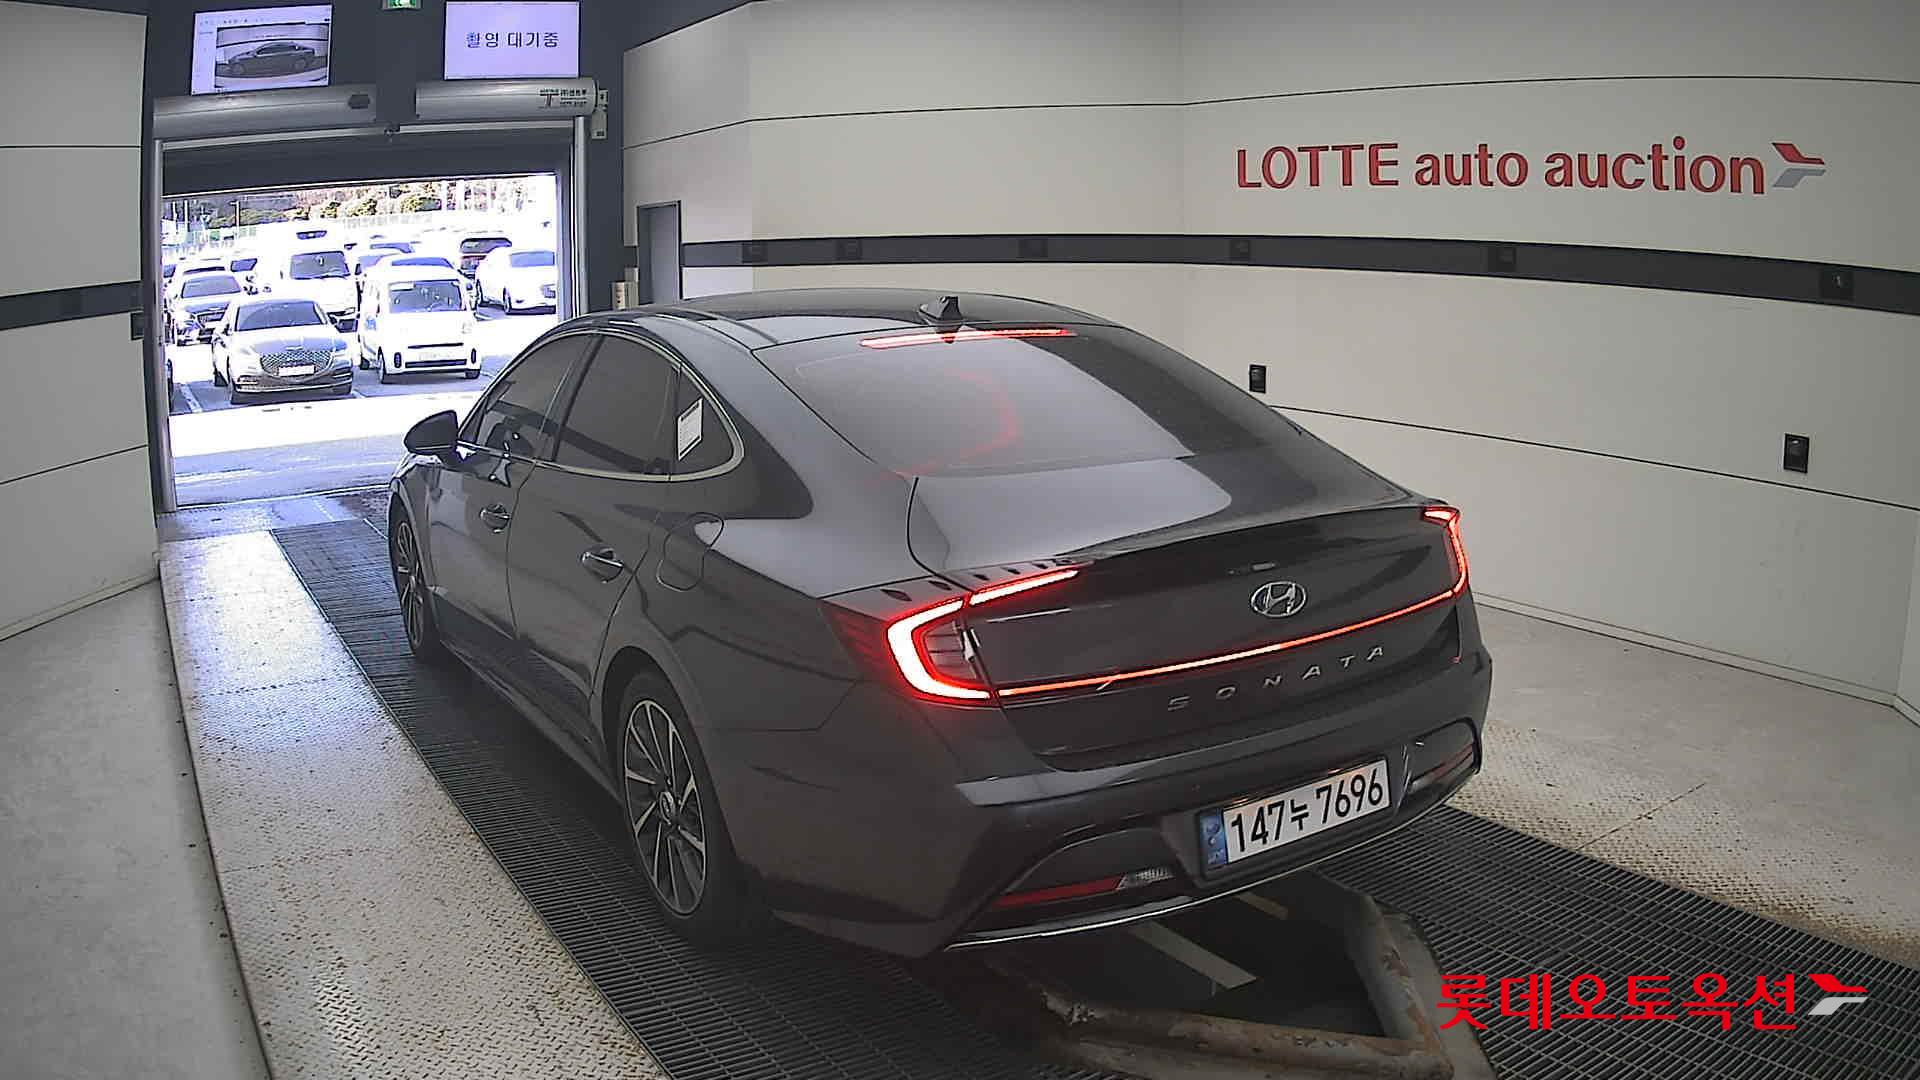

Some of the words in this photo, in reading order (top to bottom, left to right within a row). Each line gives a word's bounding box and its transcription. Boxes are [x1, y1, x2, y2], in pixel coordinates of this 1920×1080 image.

[507, 32, 558, 48] 대기중
[1237, 143, 1399, 189] LOTTE
[1415, 144, 1529, 188] auto
[1545, 136, 1765, 195] auction
[1167, 646, 1385, 711] SONATA
[1315, 768, 1383, 824] 7696
